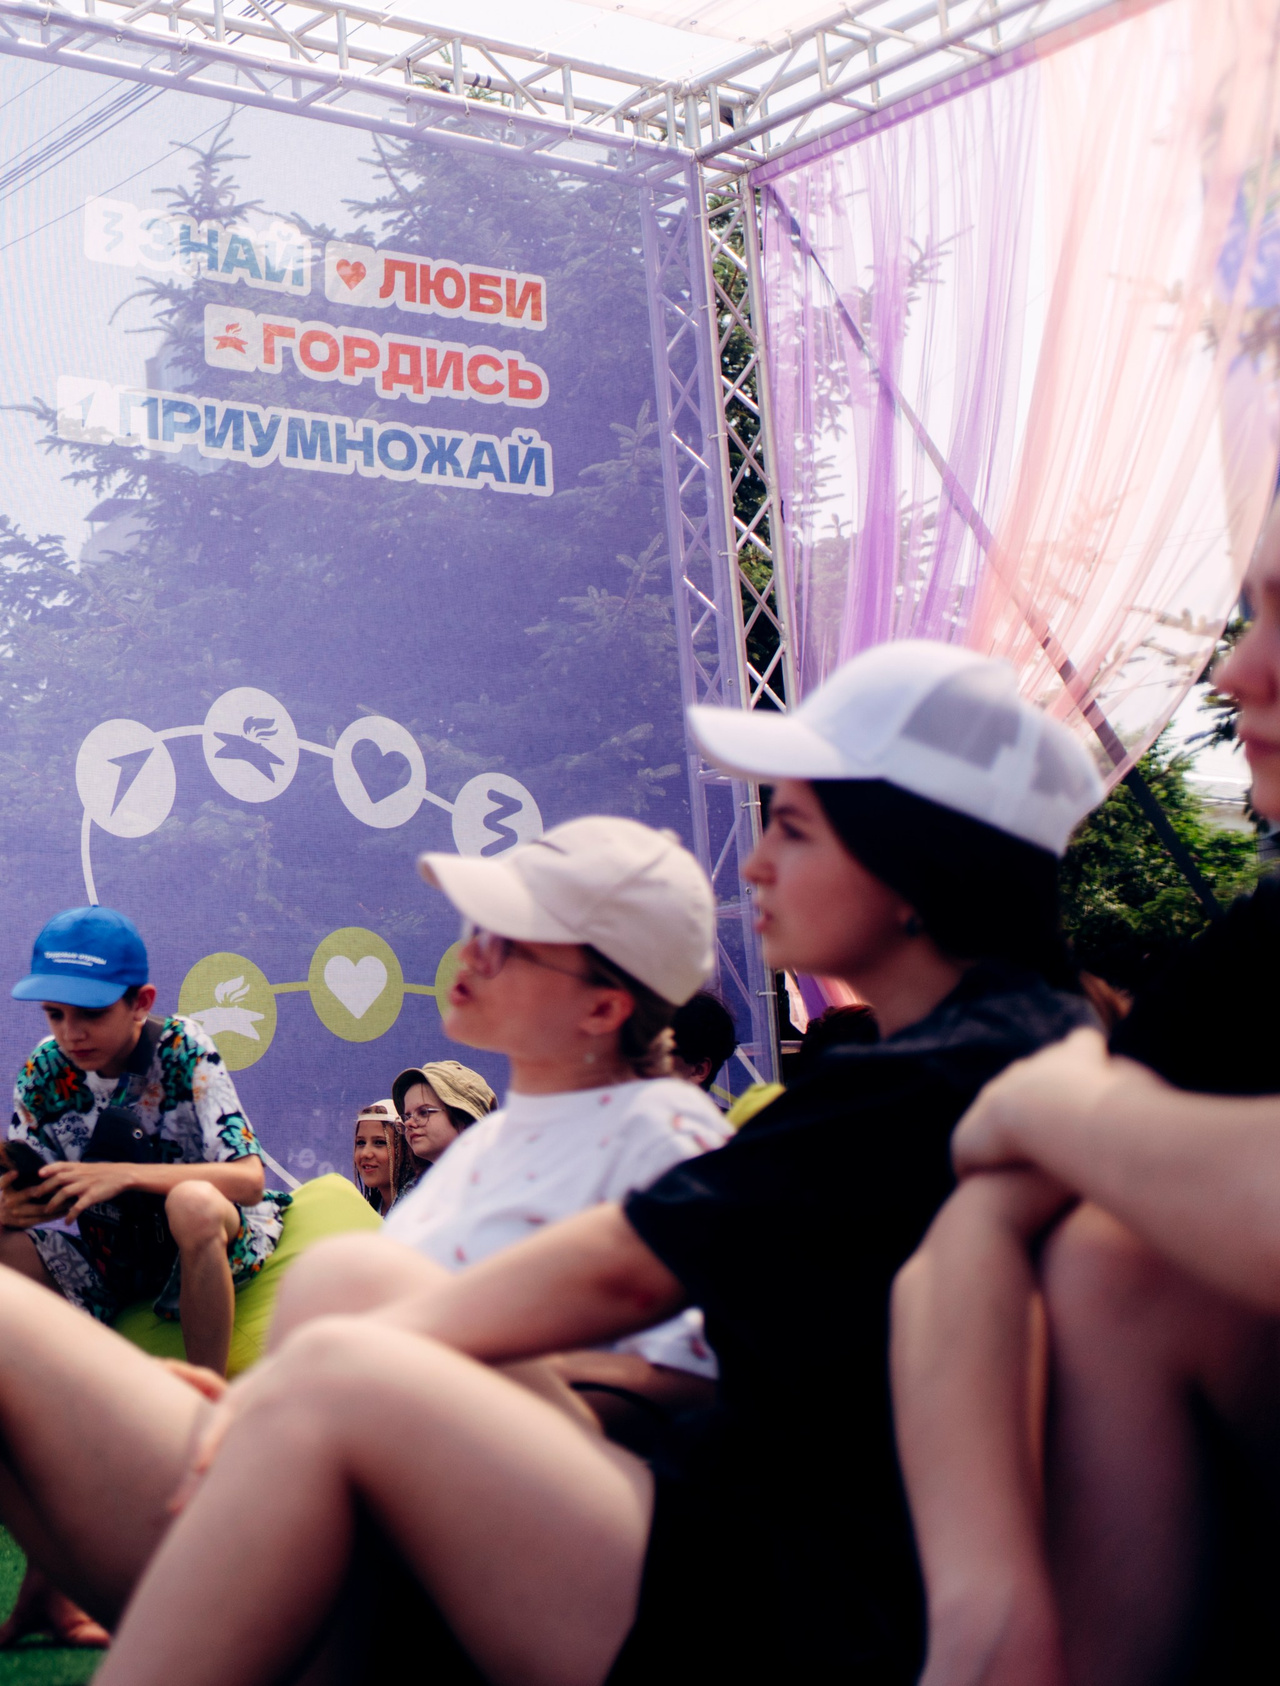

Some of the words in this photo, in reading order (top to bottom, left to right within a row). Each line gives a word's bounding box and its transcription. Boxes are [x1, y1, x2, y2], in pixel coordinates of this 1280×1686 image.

[139, 216, 305, 287] ЗНАЙ
[379, 257, 544, 323] ЛЮБИ
[261, 322, 544, 401] ГОРДИСЬ
[119, 392, 548, 488] ПРИУМНОЖАЙ
